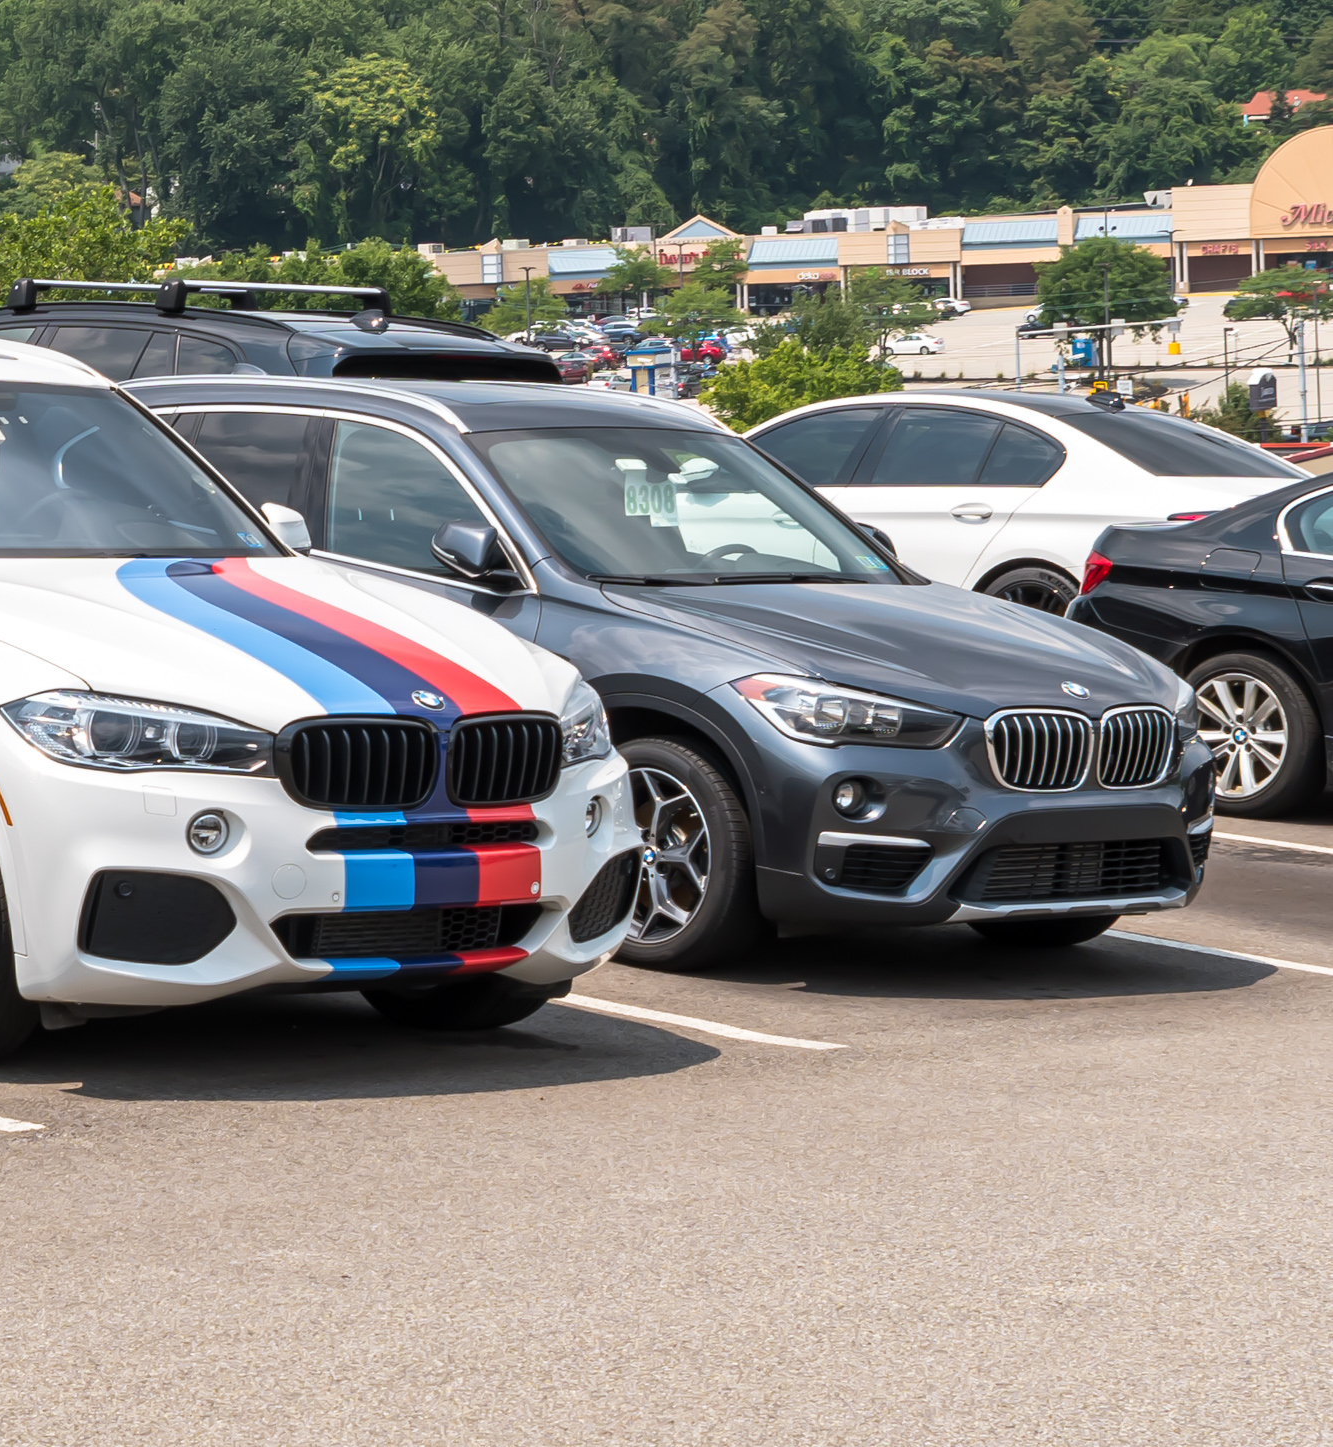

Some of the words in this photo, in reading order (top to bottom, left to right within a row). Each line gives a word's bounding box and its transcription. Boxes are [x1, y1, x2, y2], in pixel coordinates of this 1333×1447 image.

[1201, 243, 1239, 255] CRAFTS
[901, 266, 930, 276] BLOCK
[626, 484, 675, 514] 8308
